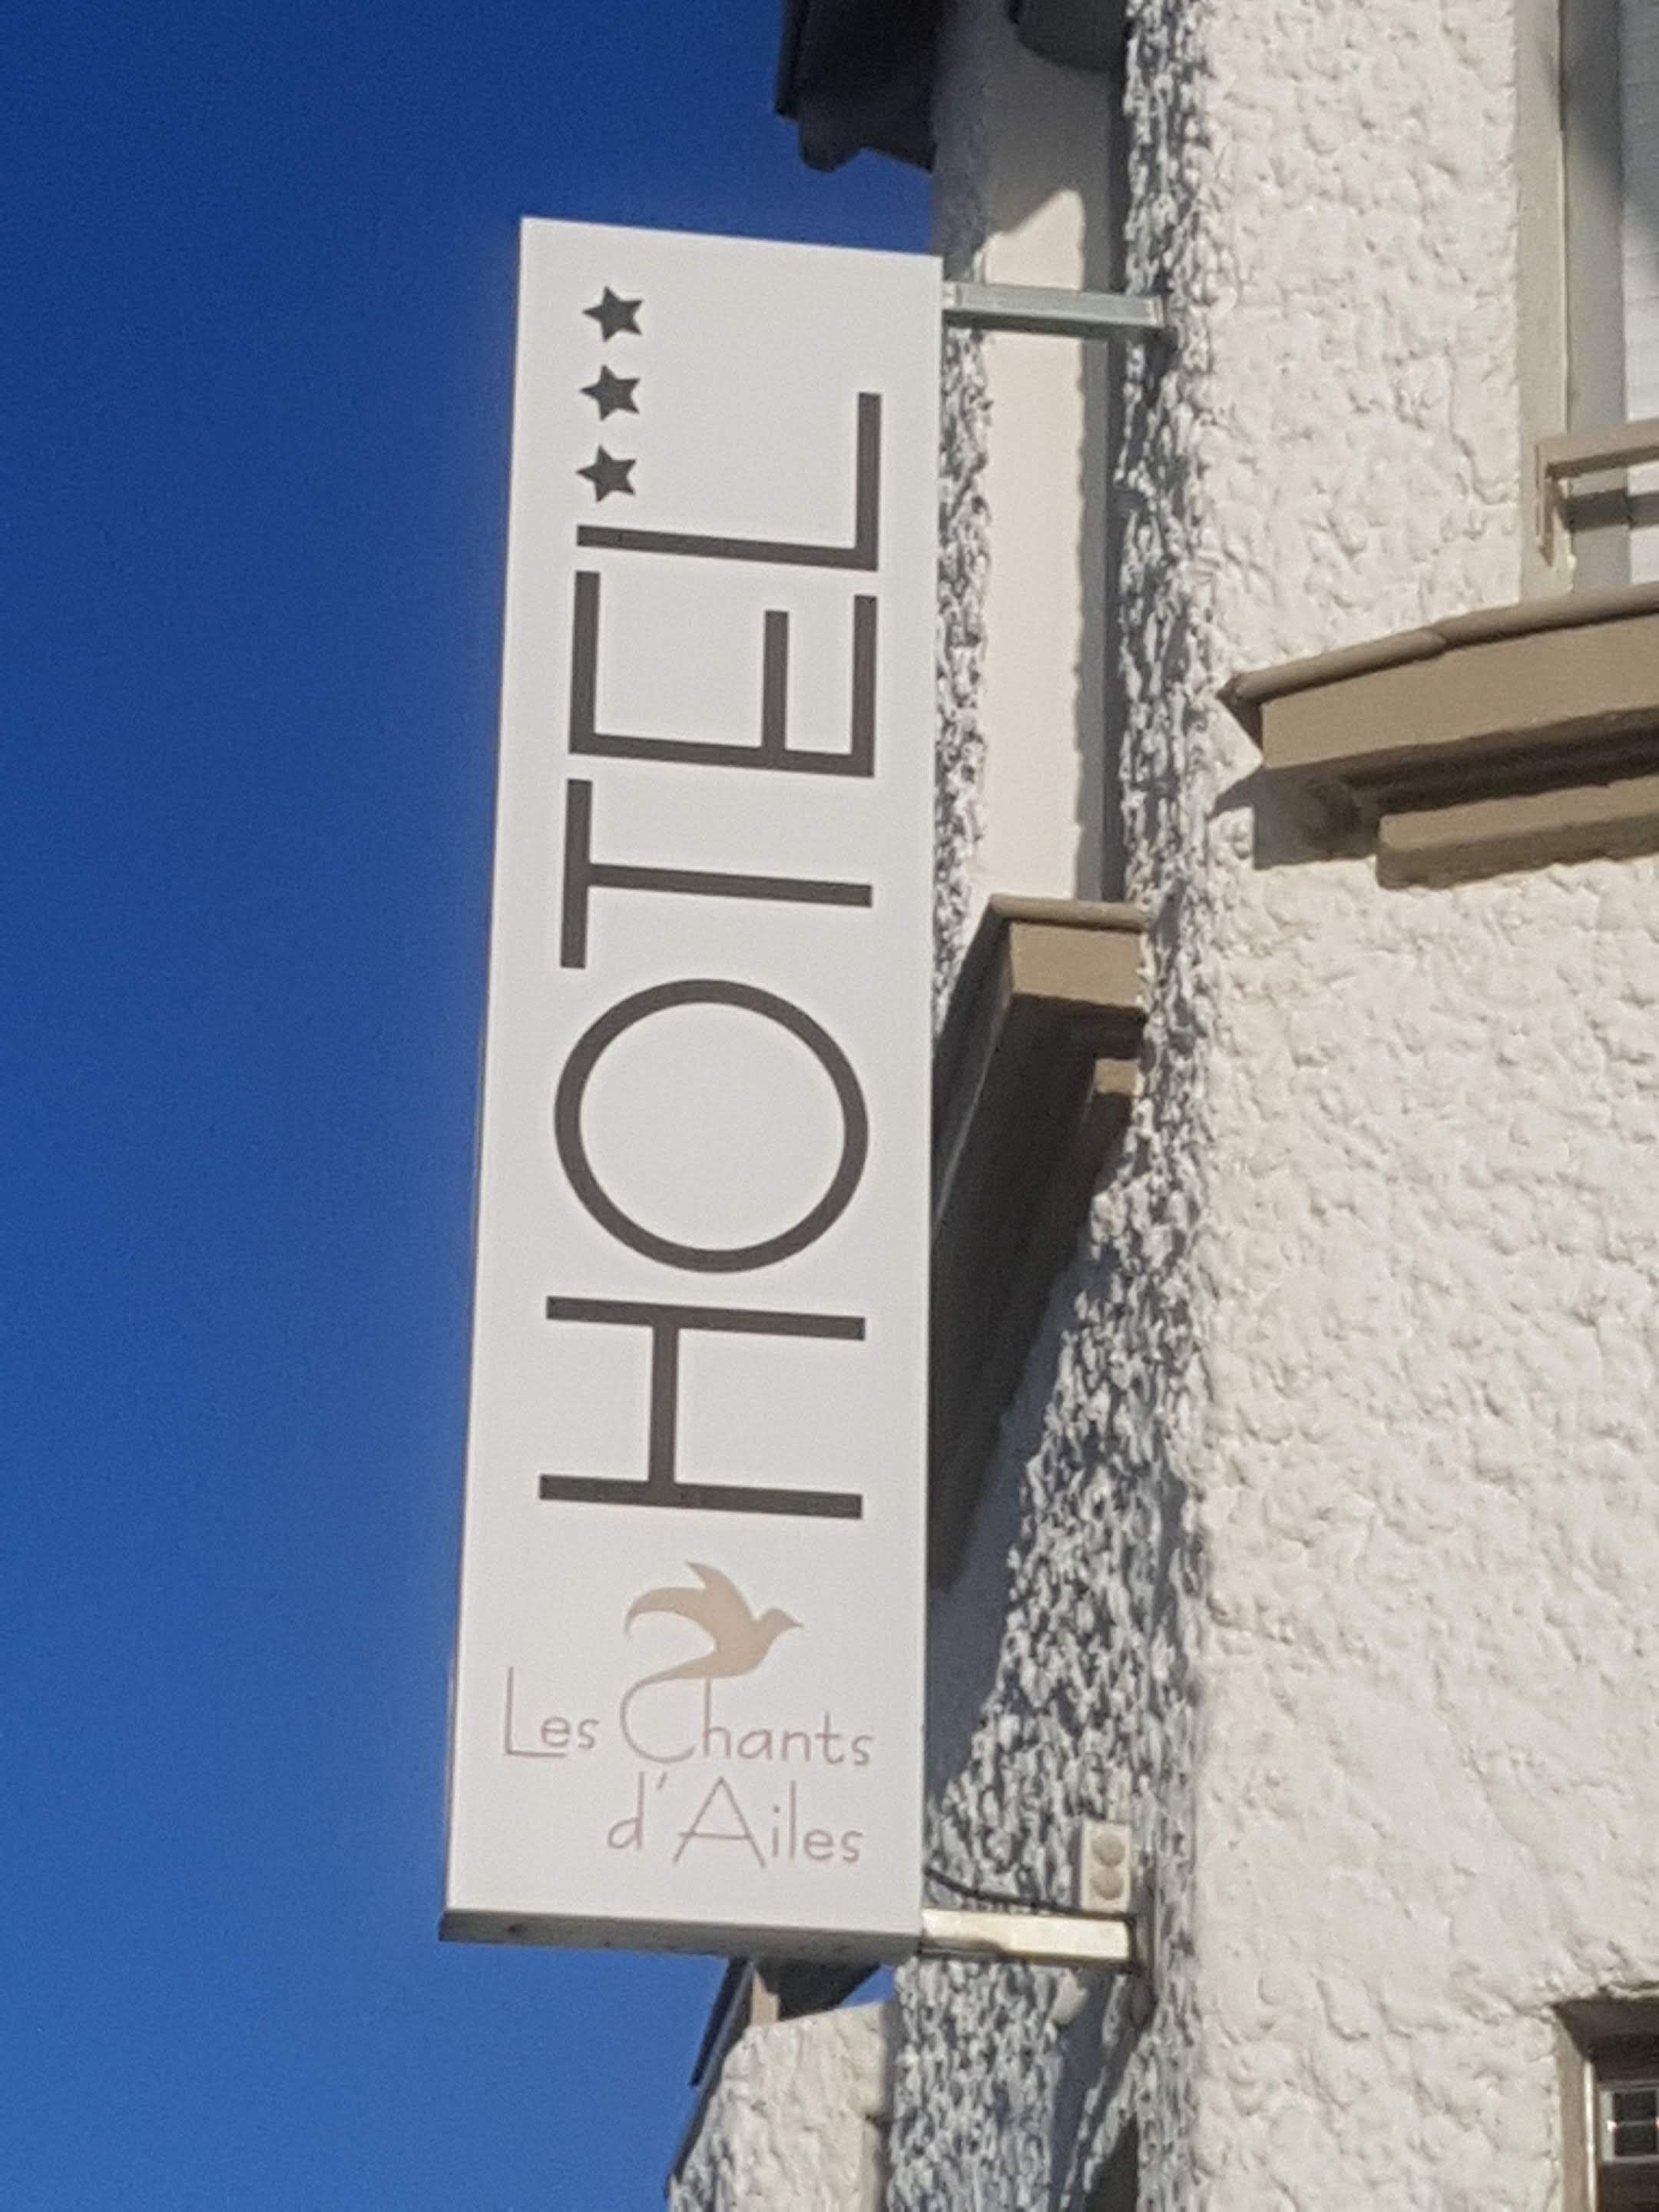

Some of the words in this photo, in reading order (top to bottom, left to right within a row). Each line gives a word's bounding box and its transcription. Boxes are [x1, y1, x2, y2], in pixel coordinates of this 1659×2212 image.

[540, 392, 881, 1519] HOTEL
[504, 1666, 601, 1760] Les
[620, 1670, 874, 1767] Chants
[607, 1771, 864, 1869] d'Ailes
